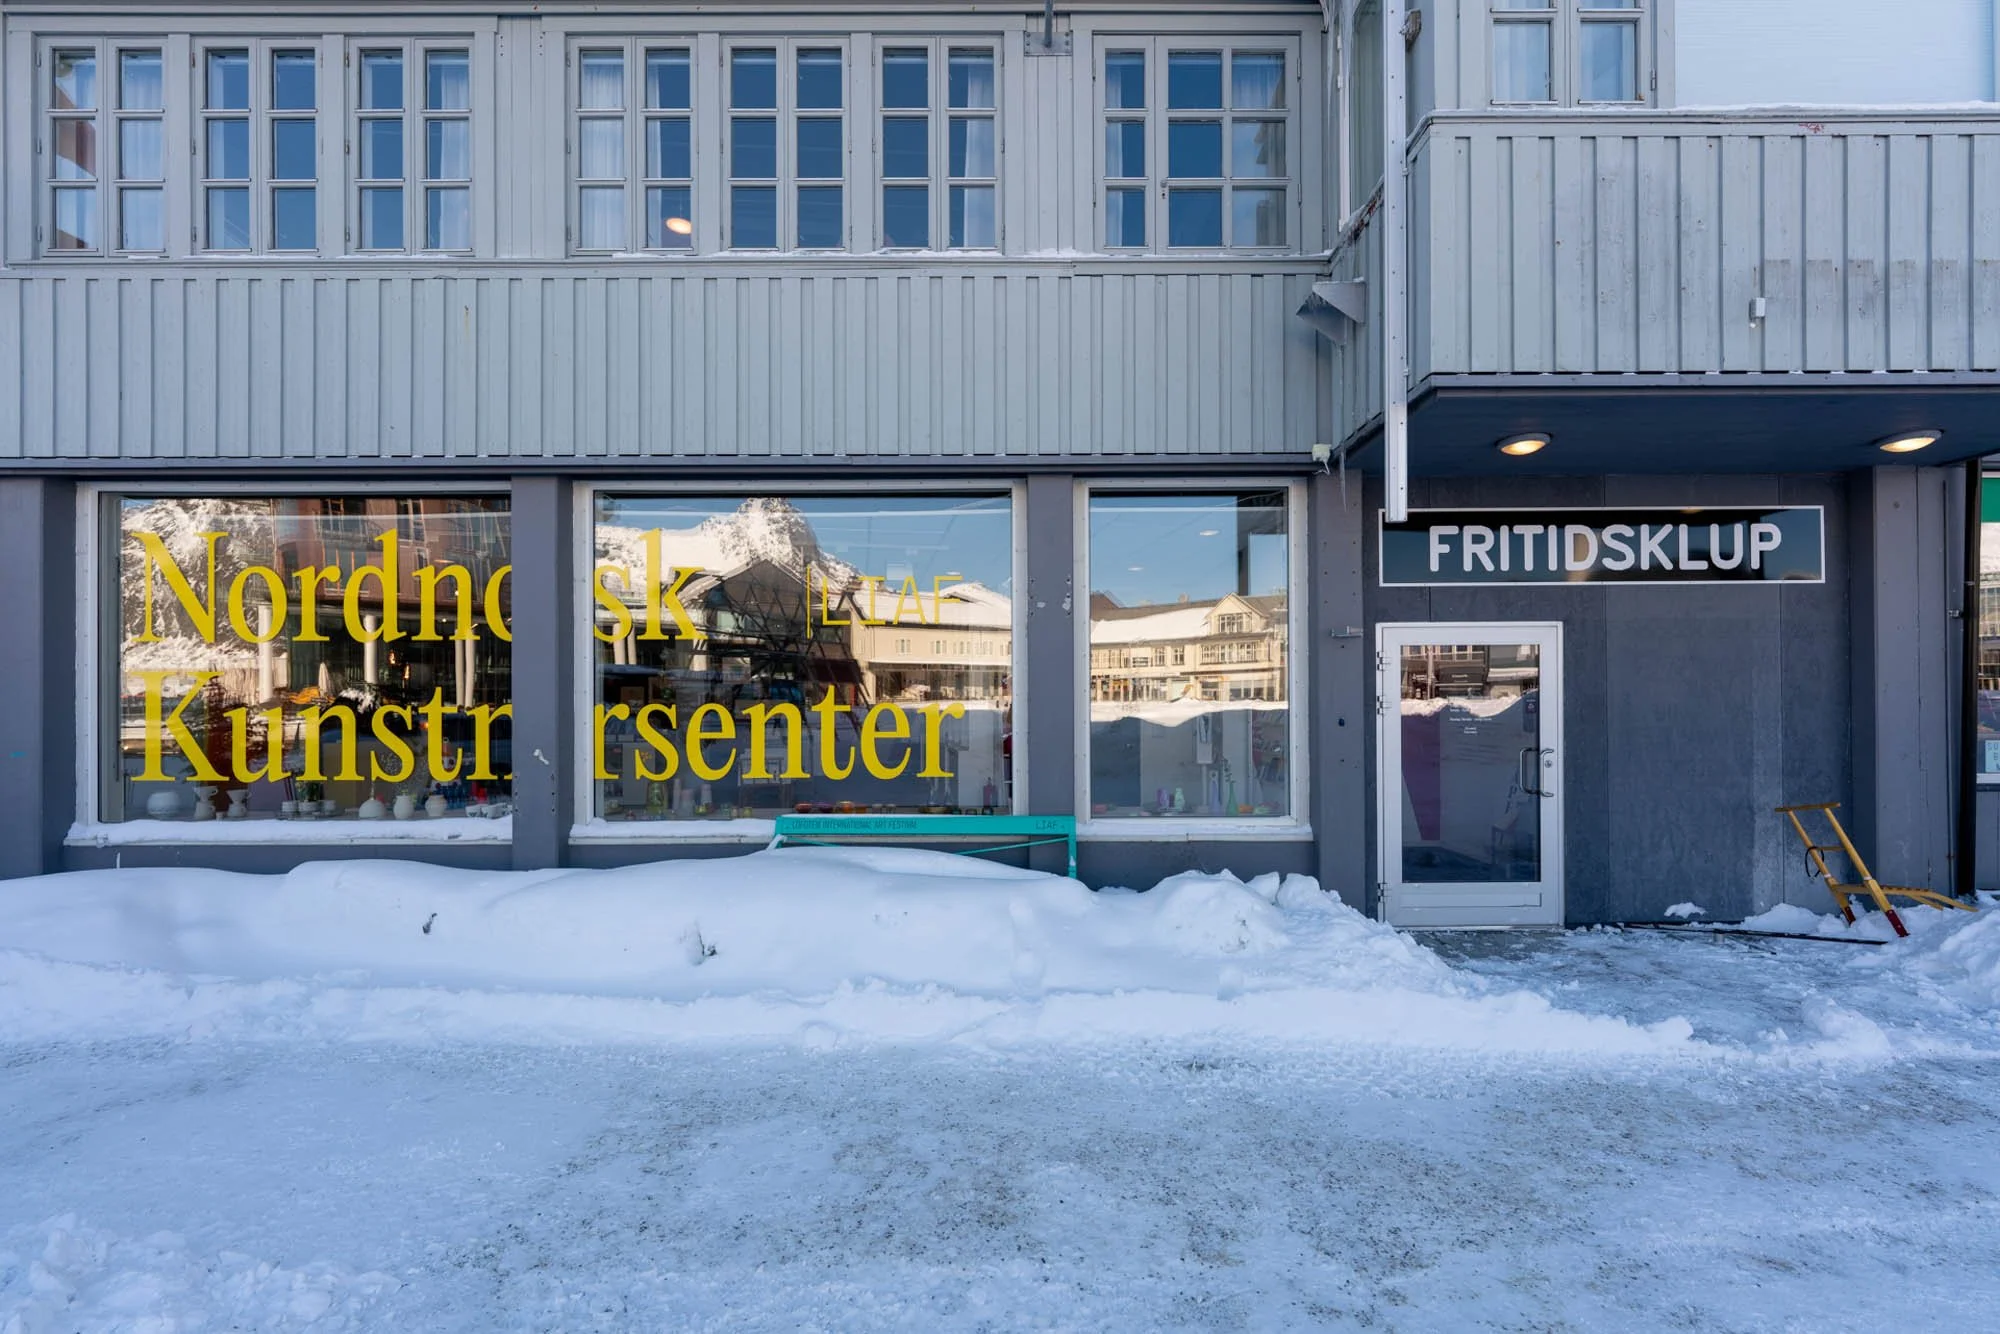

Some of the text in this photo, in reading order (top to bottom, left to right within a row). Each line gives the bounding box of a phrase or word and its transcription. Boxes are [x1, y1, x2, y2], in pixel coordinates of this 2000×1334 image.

[1428, 522, 1782, 573] FRITIDSKLUP
[822, 575, 964, 626] LIAF
[130, 671, 966, 784] Kunstnrsenter
[1035, 819, 1060, 830] LIAF
